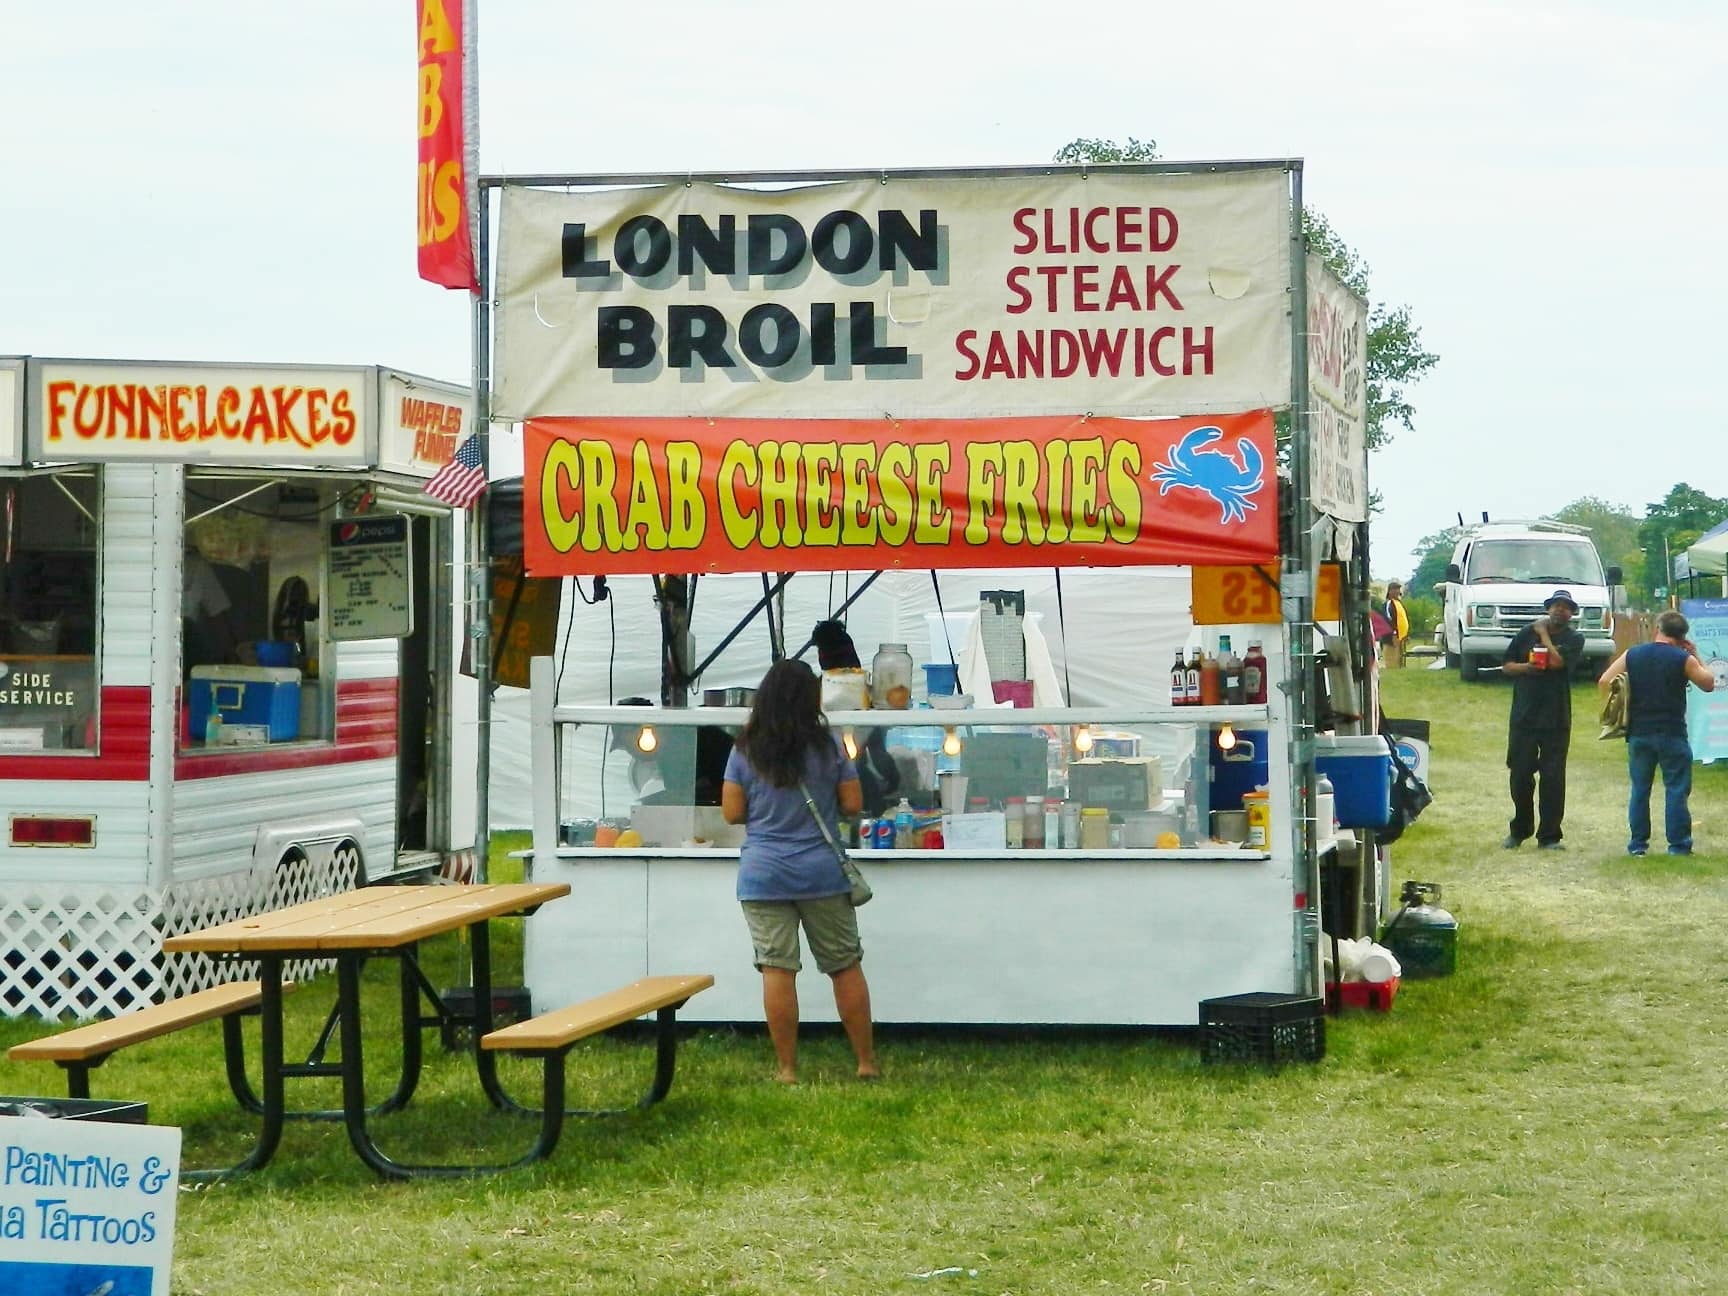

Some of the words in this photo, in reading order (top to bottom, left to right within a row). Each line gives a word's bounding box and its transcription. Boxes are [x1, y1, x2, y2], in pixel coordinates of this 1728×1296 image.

[561, 209, 949, 292] LONDON
[1012, 206, 1179, 255] SLICED
[1006, 264, 1184, 315] STEAK
[597, 301, 923, 383] BROIL
[954, 326, 1214, 381] SANDWICH
[401, 396, 462, 434] WAFFLES
[540, 438, 705, 553] CRAB
[717, 438, 951, 550] CHEESE
[964, 434, 1143, 546] FRIES
[0, 690, 74, 705] SERVICE
[12, 672, 51, 687] SIDE
[138, 1156, 171, 1195] &
